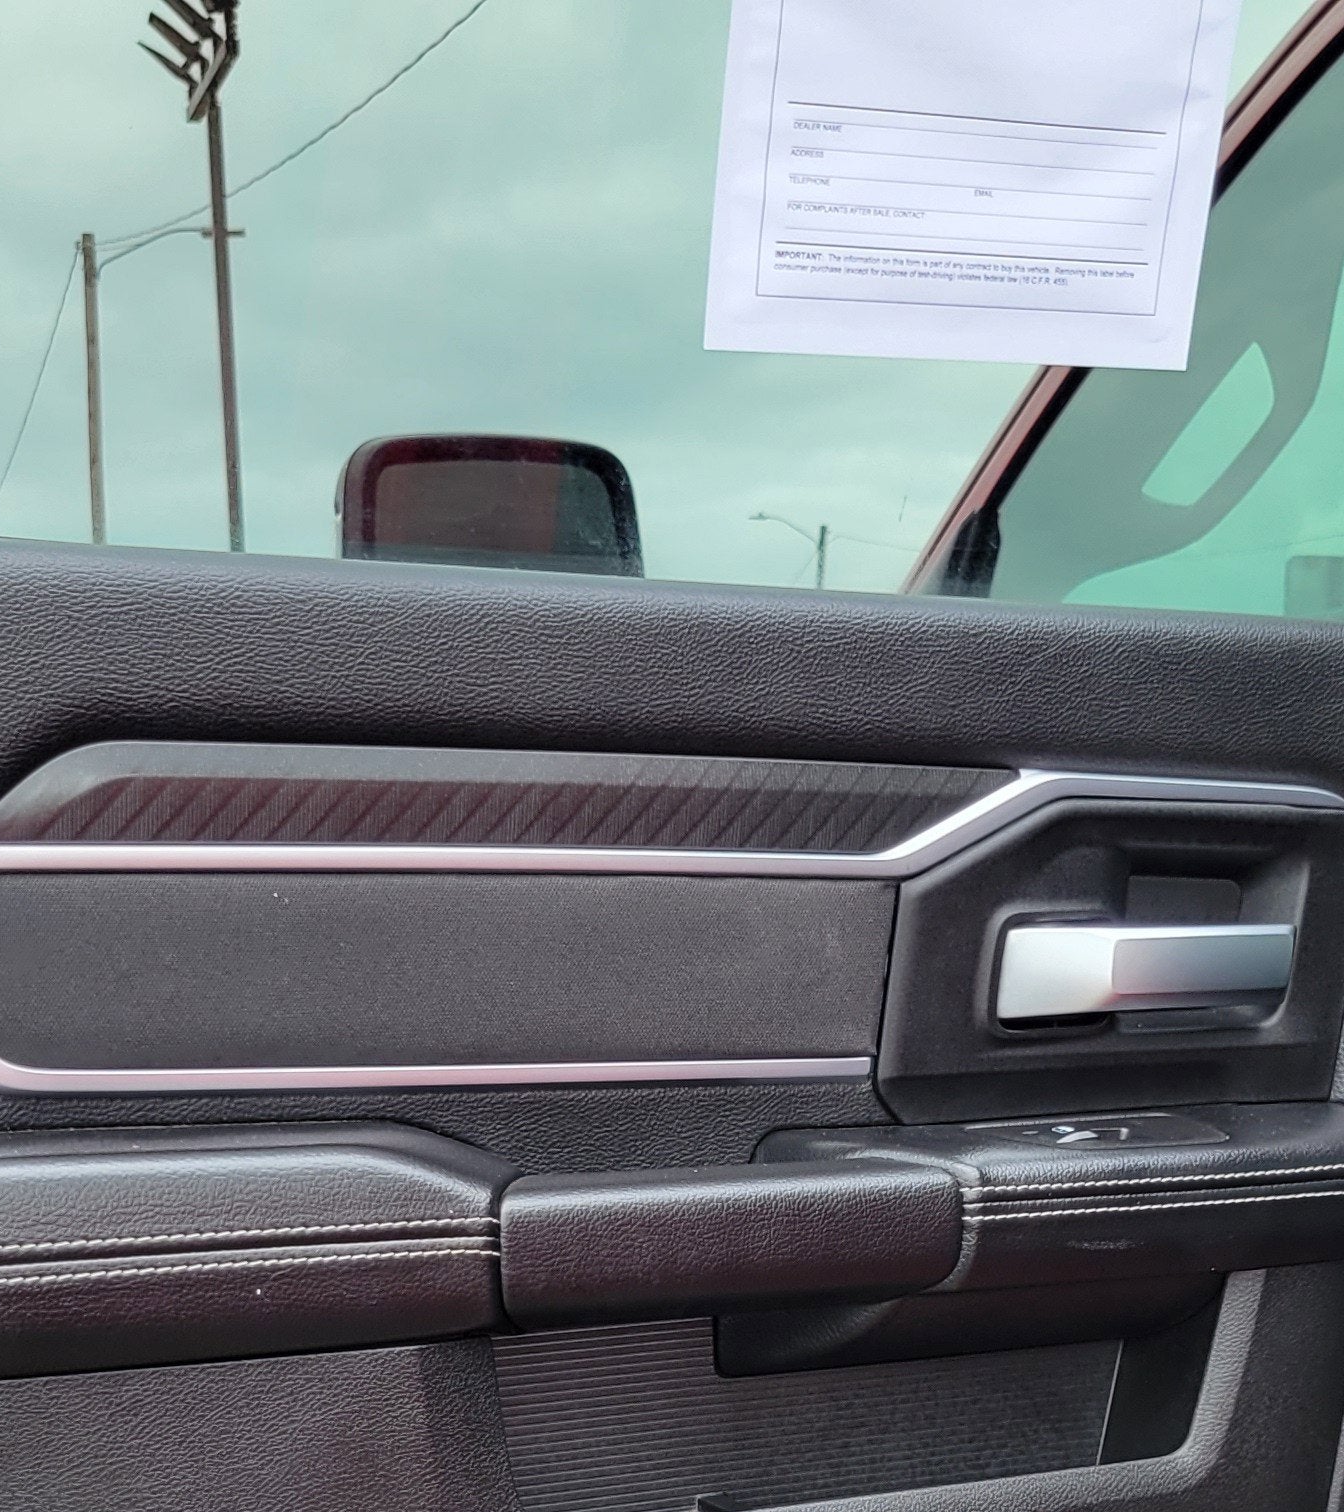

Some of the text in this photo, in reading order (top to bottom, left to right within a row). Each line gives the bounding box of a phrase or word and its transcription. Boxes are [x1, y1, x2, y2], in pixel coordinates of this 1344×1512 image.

[793, 121, 842, 133] DEALER NAME
[790, 149, 824, 159] ADDRESS
[788, 175, 831, 187] TELEPHONE
[787, 203, 802, 211] FOR
[803, 204, 848, 214] COMPLAINTS
[850, 207, 872, 216] AFTER
